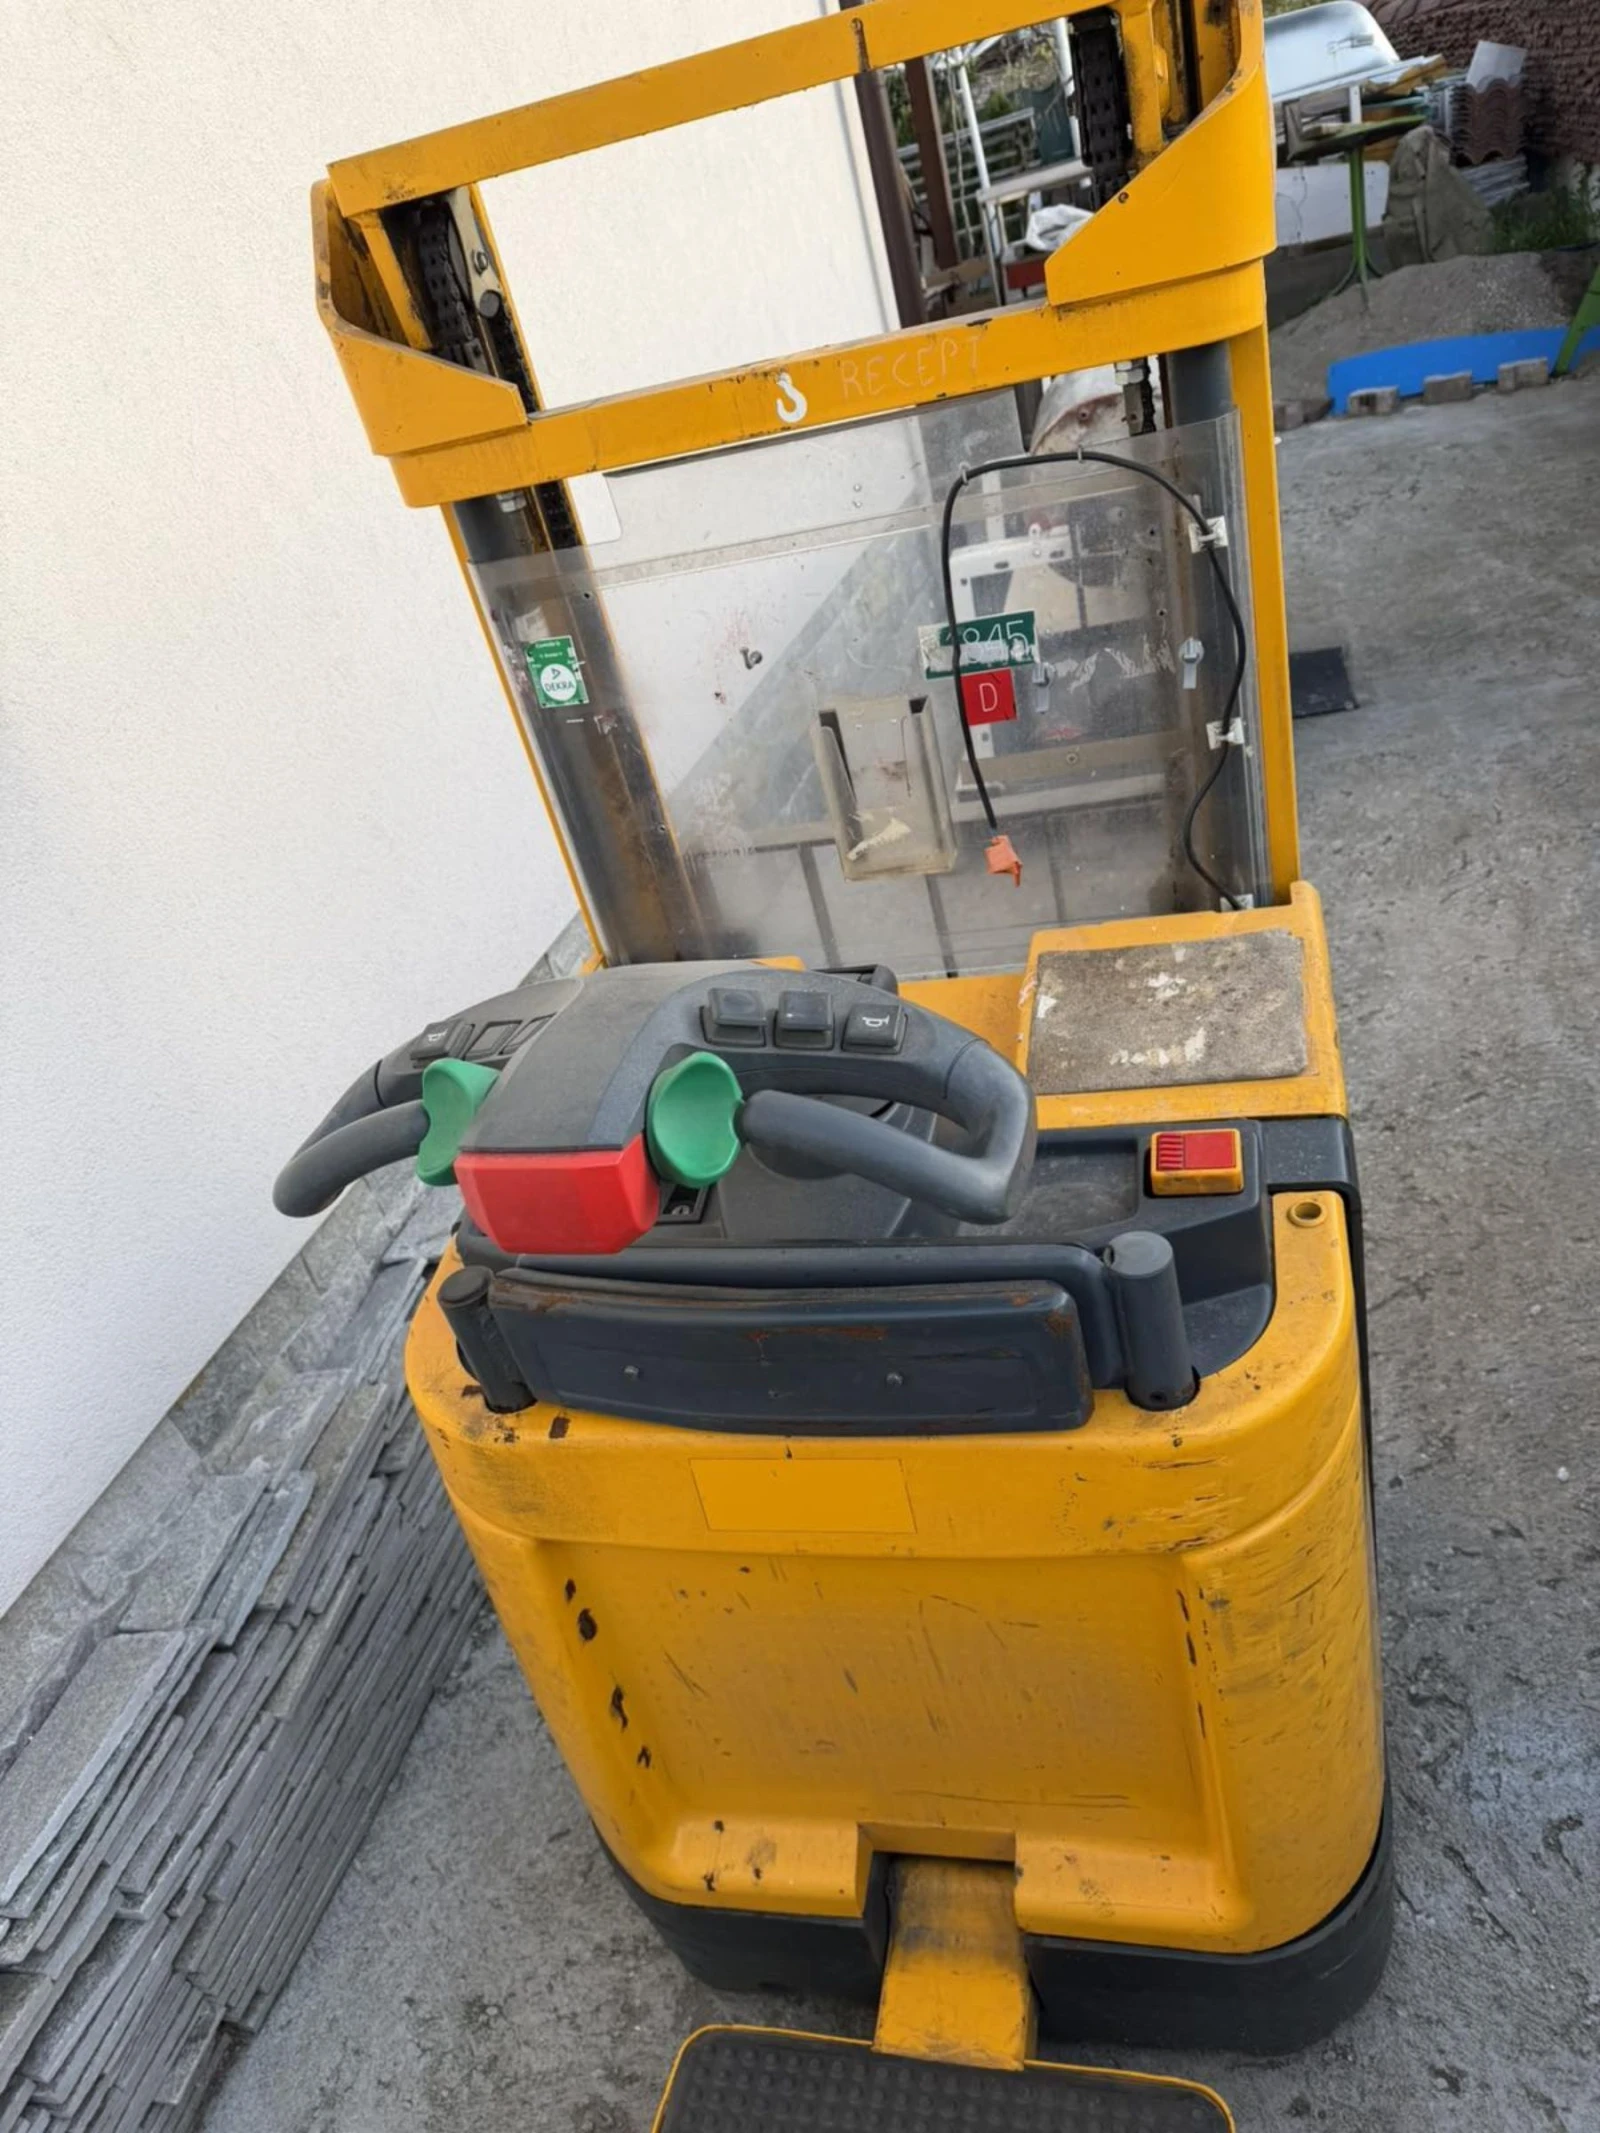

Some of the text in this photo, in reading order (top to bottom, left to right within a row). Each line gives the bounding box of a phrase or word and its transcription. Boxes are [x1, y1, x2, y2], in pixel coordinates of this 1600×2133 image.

[839, 335, 982, 399] RECEPT
[545, 681, 575, 693] DEKRA
[979, 682, 998, 713] D
